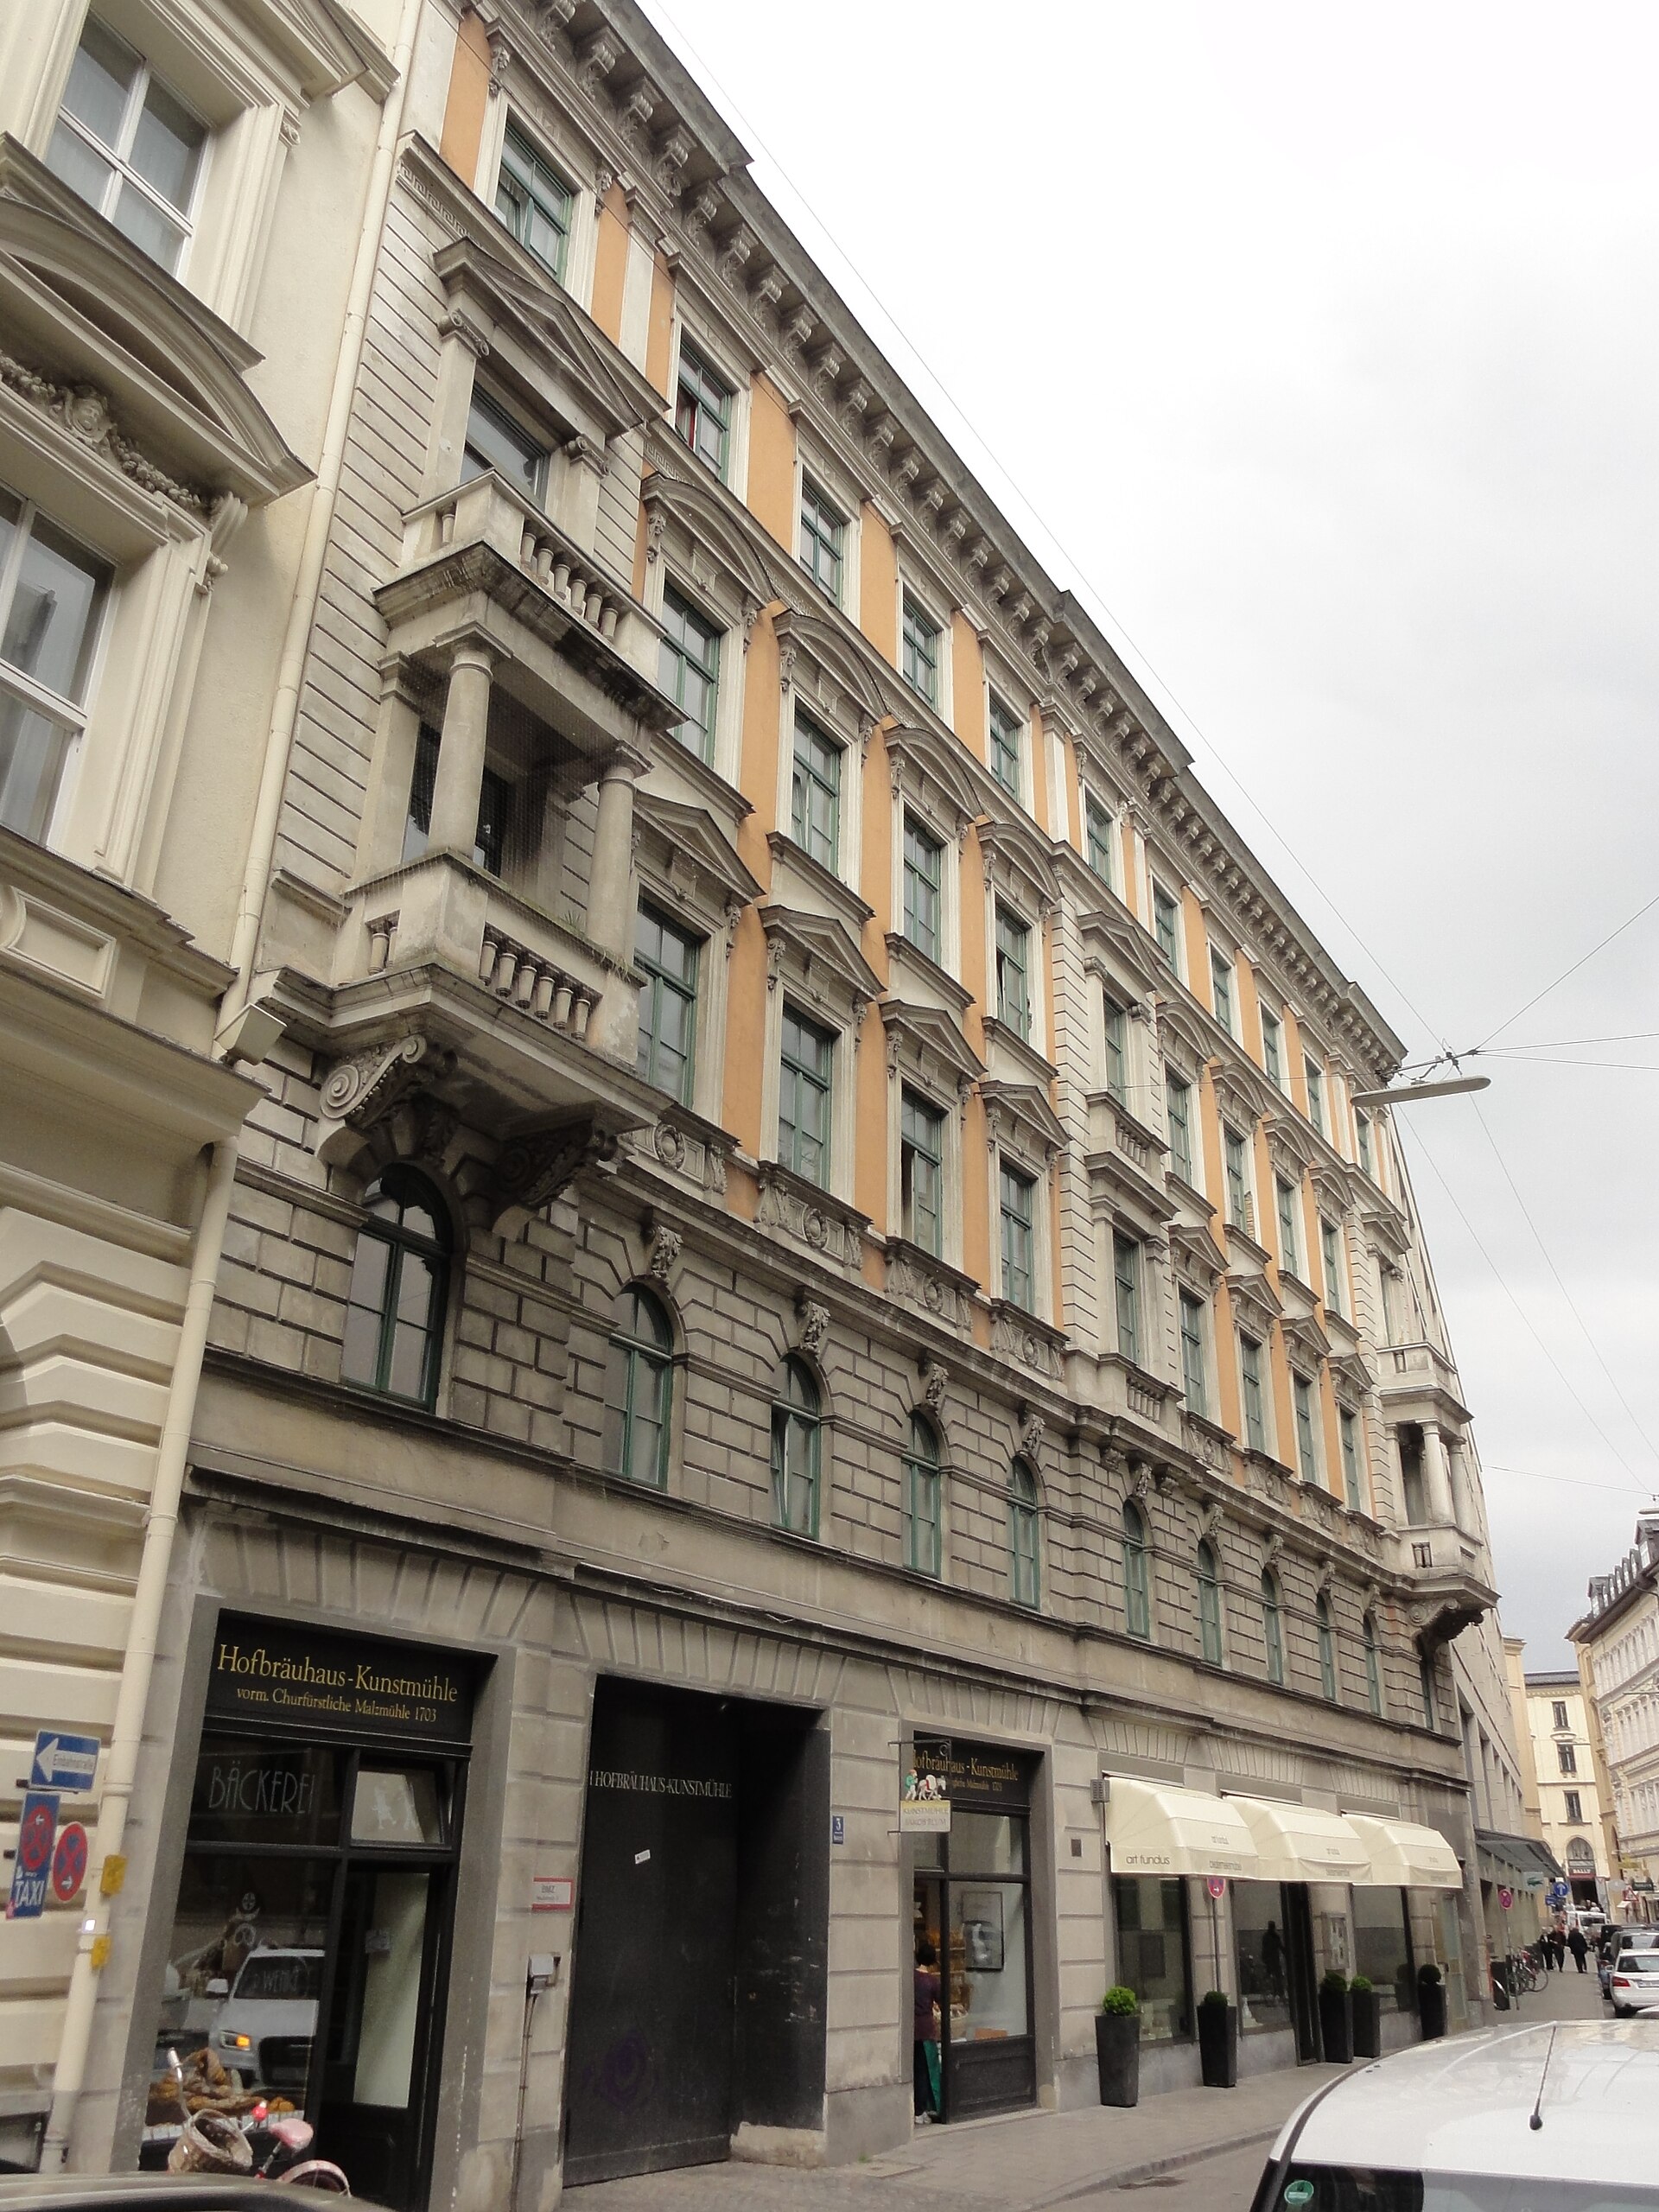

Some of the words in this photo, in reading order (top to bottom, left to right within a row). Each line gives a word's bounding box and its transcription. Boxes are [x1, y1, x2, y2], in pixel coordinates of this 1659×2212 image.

[218, 1643, 458, 1702] Hofbräuhaus-Kunstmühle
[237, 1688, 270, 1701] vorm.
[272, 1688, 352, 1712] Churfürstliche
[354, 1699, 410, 1719] Malzmühle
[415, 1707, 437, 1722] 1703
[208, 1760, 315, 1814] BÄCKEREI
[836, 1817, 842, 1831] 3
[1126, 1855, 1138, 1865] art
[1140, 1855, 1171, 1865] fundus
[15, 1879, 46, 1908] TAXI
